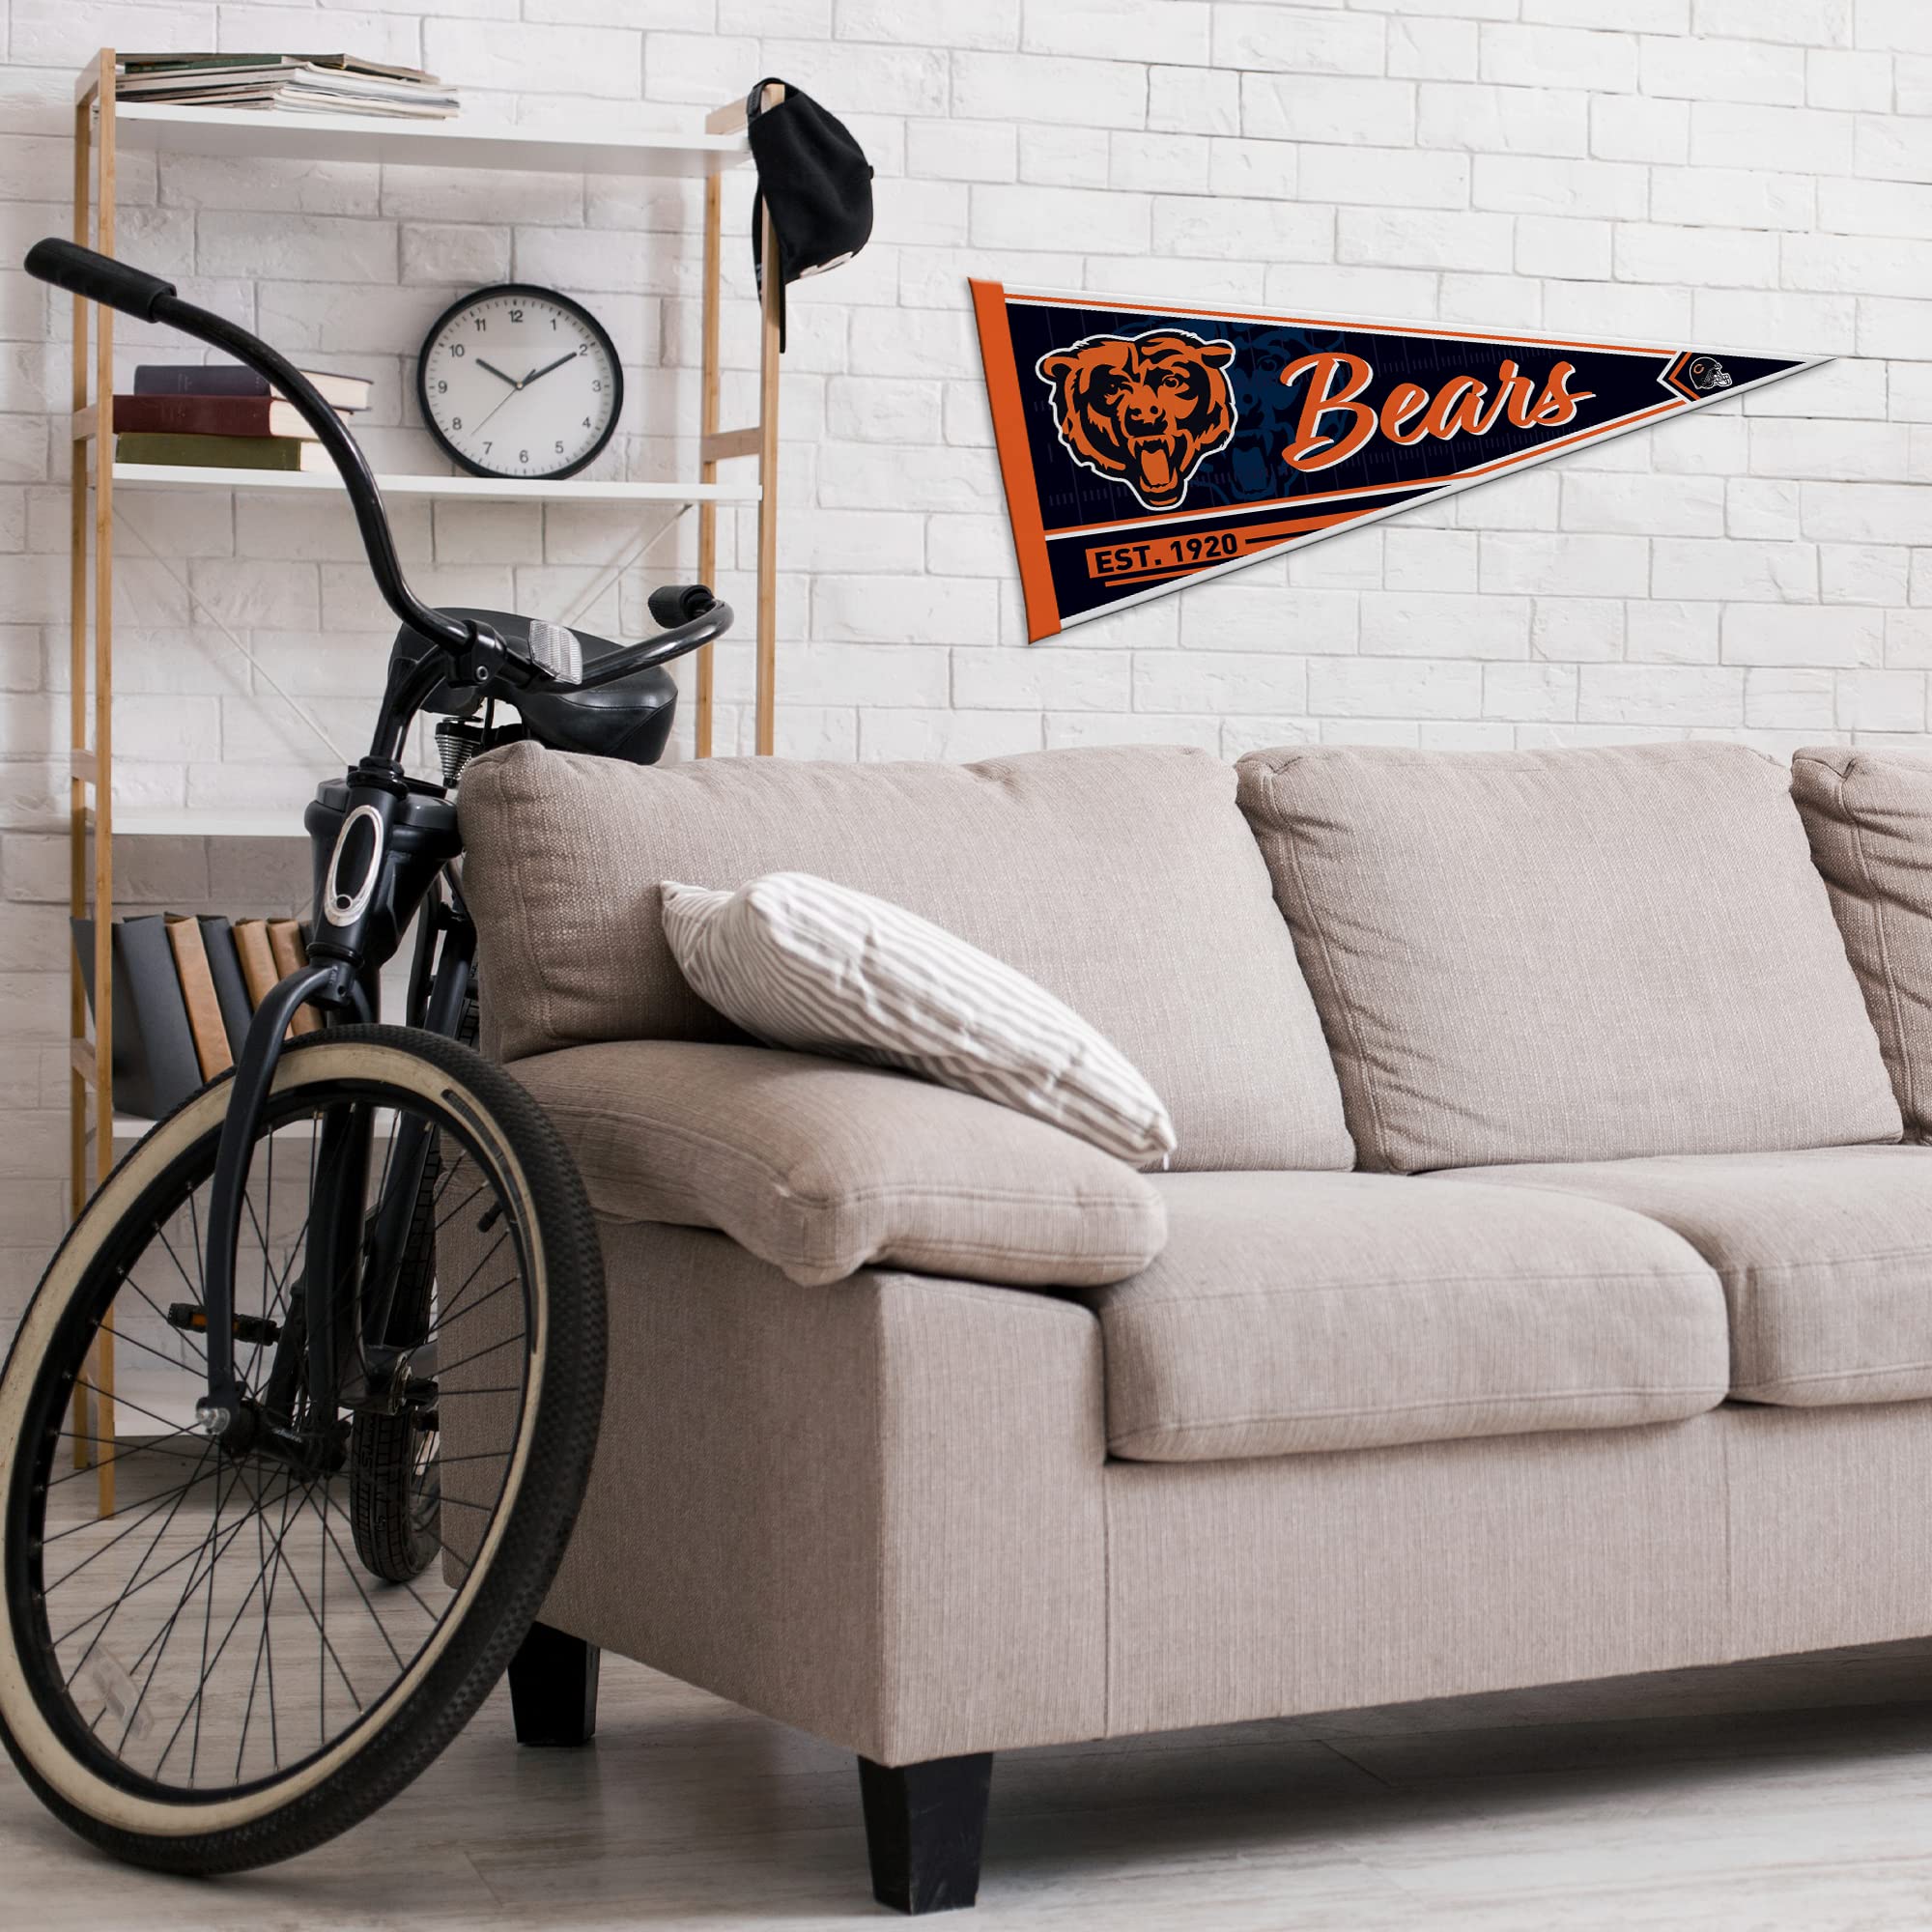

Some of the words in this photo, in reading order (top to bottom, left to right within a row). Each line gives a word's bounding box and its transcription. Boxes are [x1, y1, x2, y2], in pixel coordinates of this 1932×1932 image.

[508, 309, 524, 323] 12
[474, 319, 486, 331] 11
[550, 319, 556, 330] 1
[449, 343, 465, 356] 10
[579, 344, 587, 356] 2
[438, 380, 447, 393] 9
[592, 380, 601, 392] 3
[1279, 352, 1597, 472] Bears
[452, 417, 462, 431] 8
[582, 416, 591, 428] 4
[483, 440, 493, 454] 7
[554, 440, 564, 453] 5
[519, 450, 528, 463] 6
[1094, 545, 1162, 574] EST.
[1170, 533, 1237, 562] 1920
